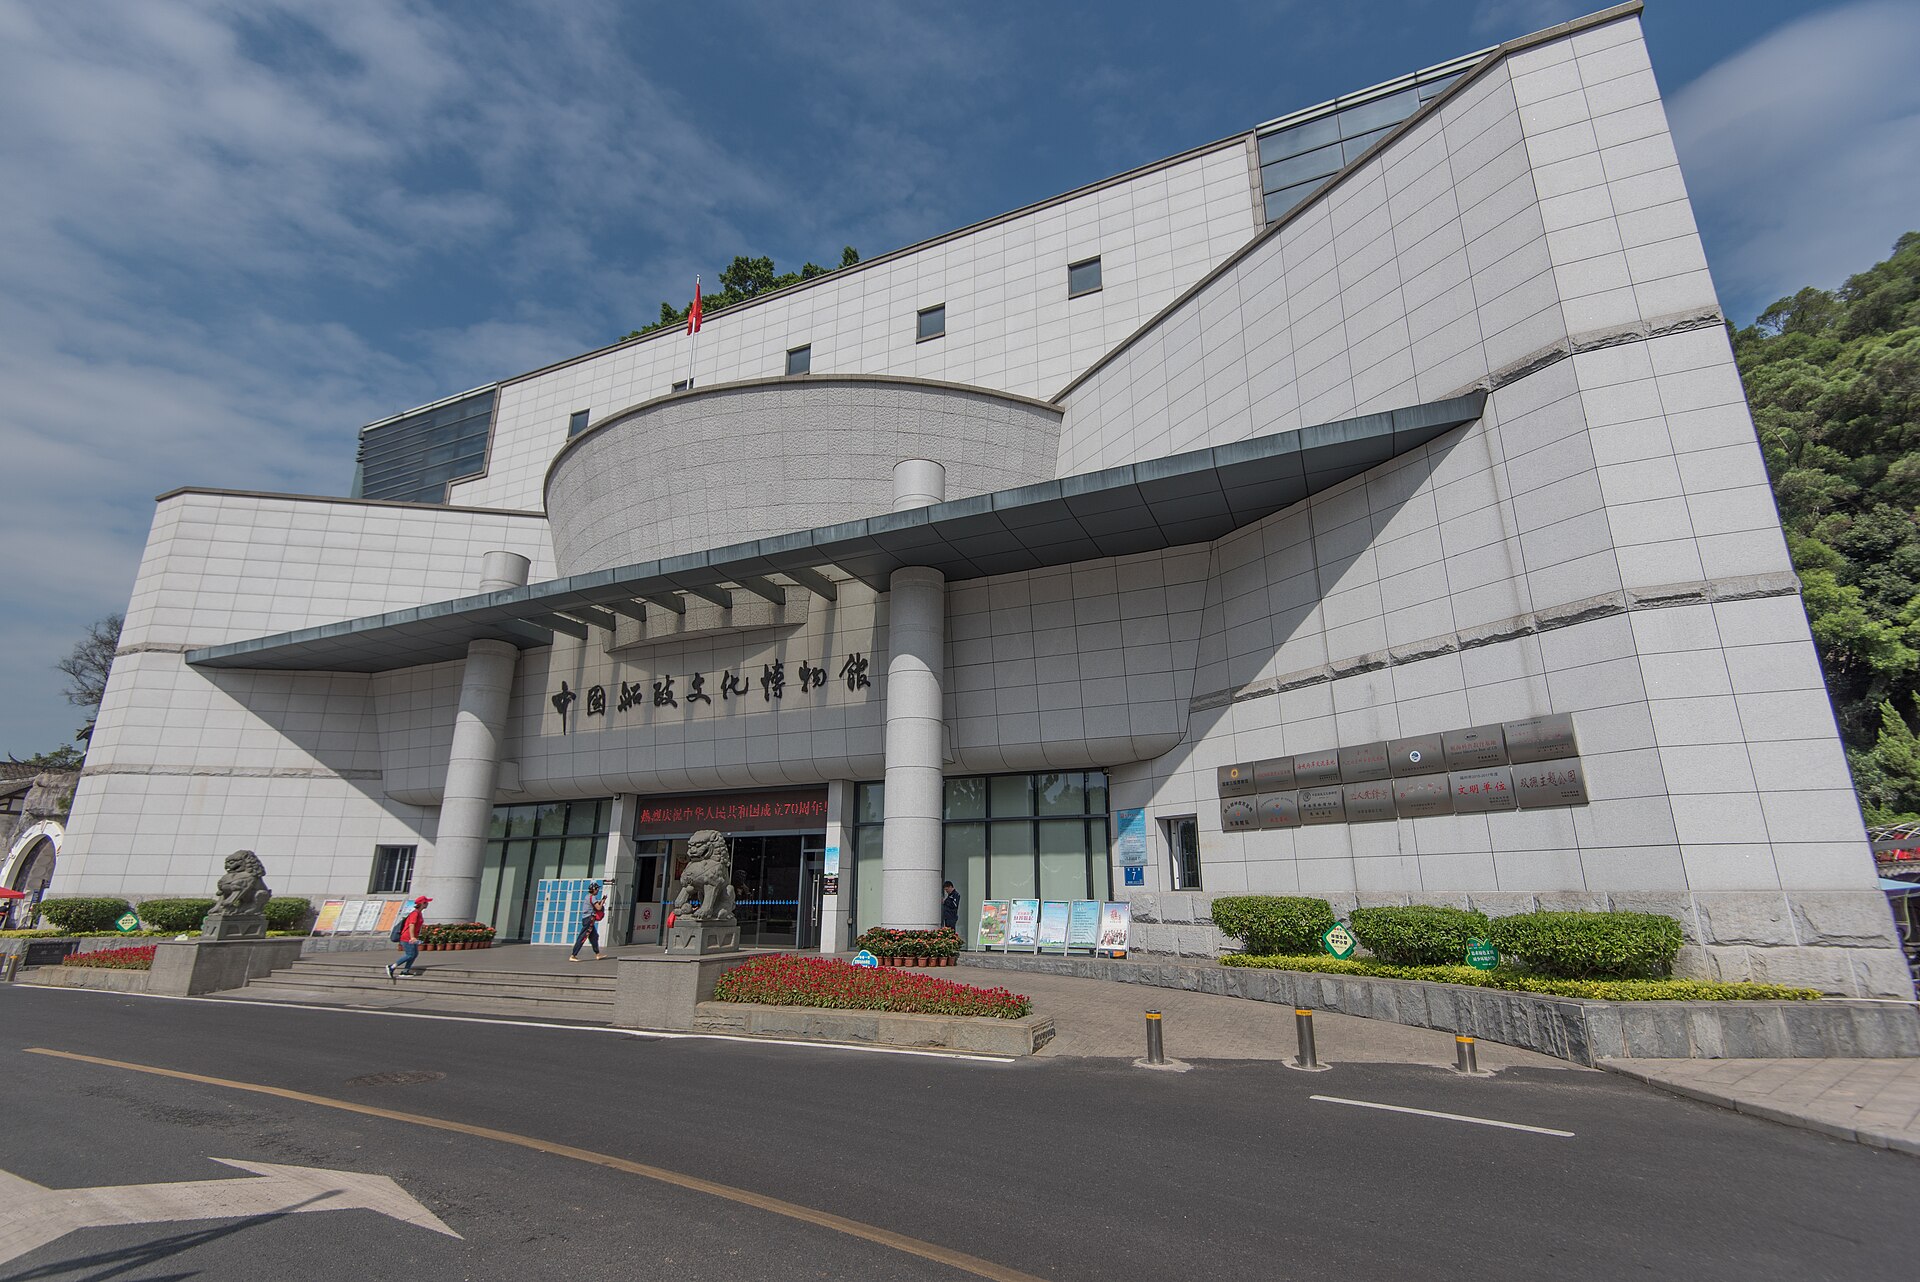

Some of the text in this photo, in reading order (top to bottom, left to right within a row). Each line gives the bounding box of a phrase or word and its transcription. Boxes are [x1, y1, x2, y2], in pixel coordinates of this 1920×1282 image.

[552, 652, 872, 736] 中国船政文化博物馆
[1457, 781, 1507, 795] 文明单位
[640, 800, 828, 824] 热烈庆祝中华人民共和国成立70周年!
[1131, 871, 1137, 881] 7
